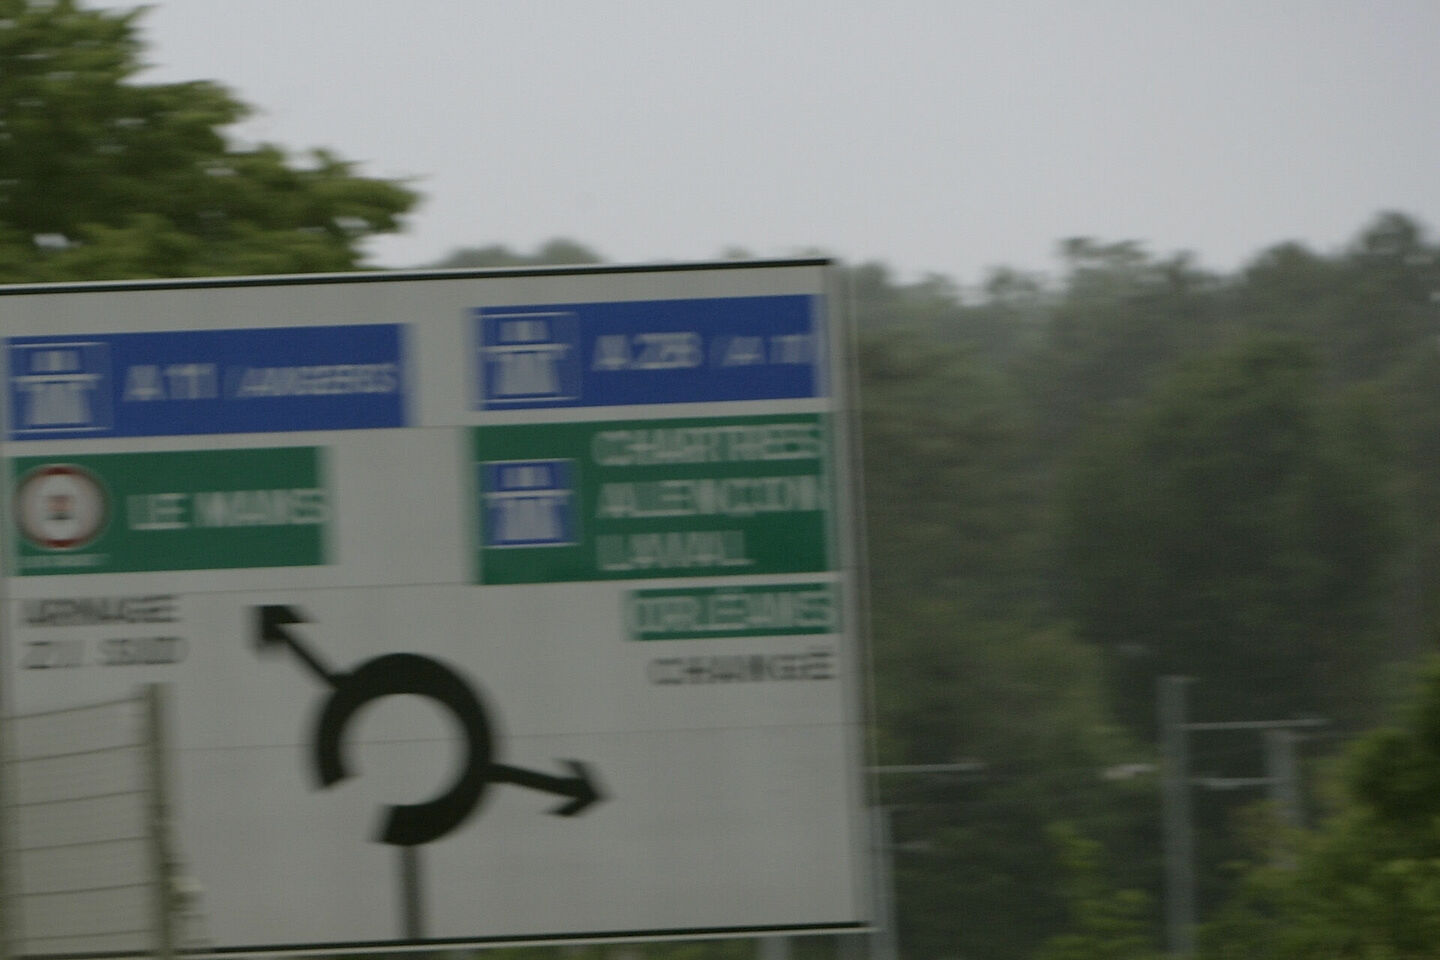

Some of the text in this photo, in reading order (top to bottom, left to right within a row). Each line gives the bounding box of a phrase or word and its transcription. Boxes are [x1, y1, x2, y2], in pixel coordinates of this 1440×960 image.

[592, 423, 822, 466] CHARTRES
[128, 488, 330, 531] LE MANS
[596, 530, 754, 571] LAVAL
[23, 594, 179, 628] ARNAGE
